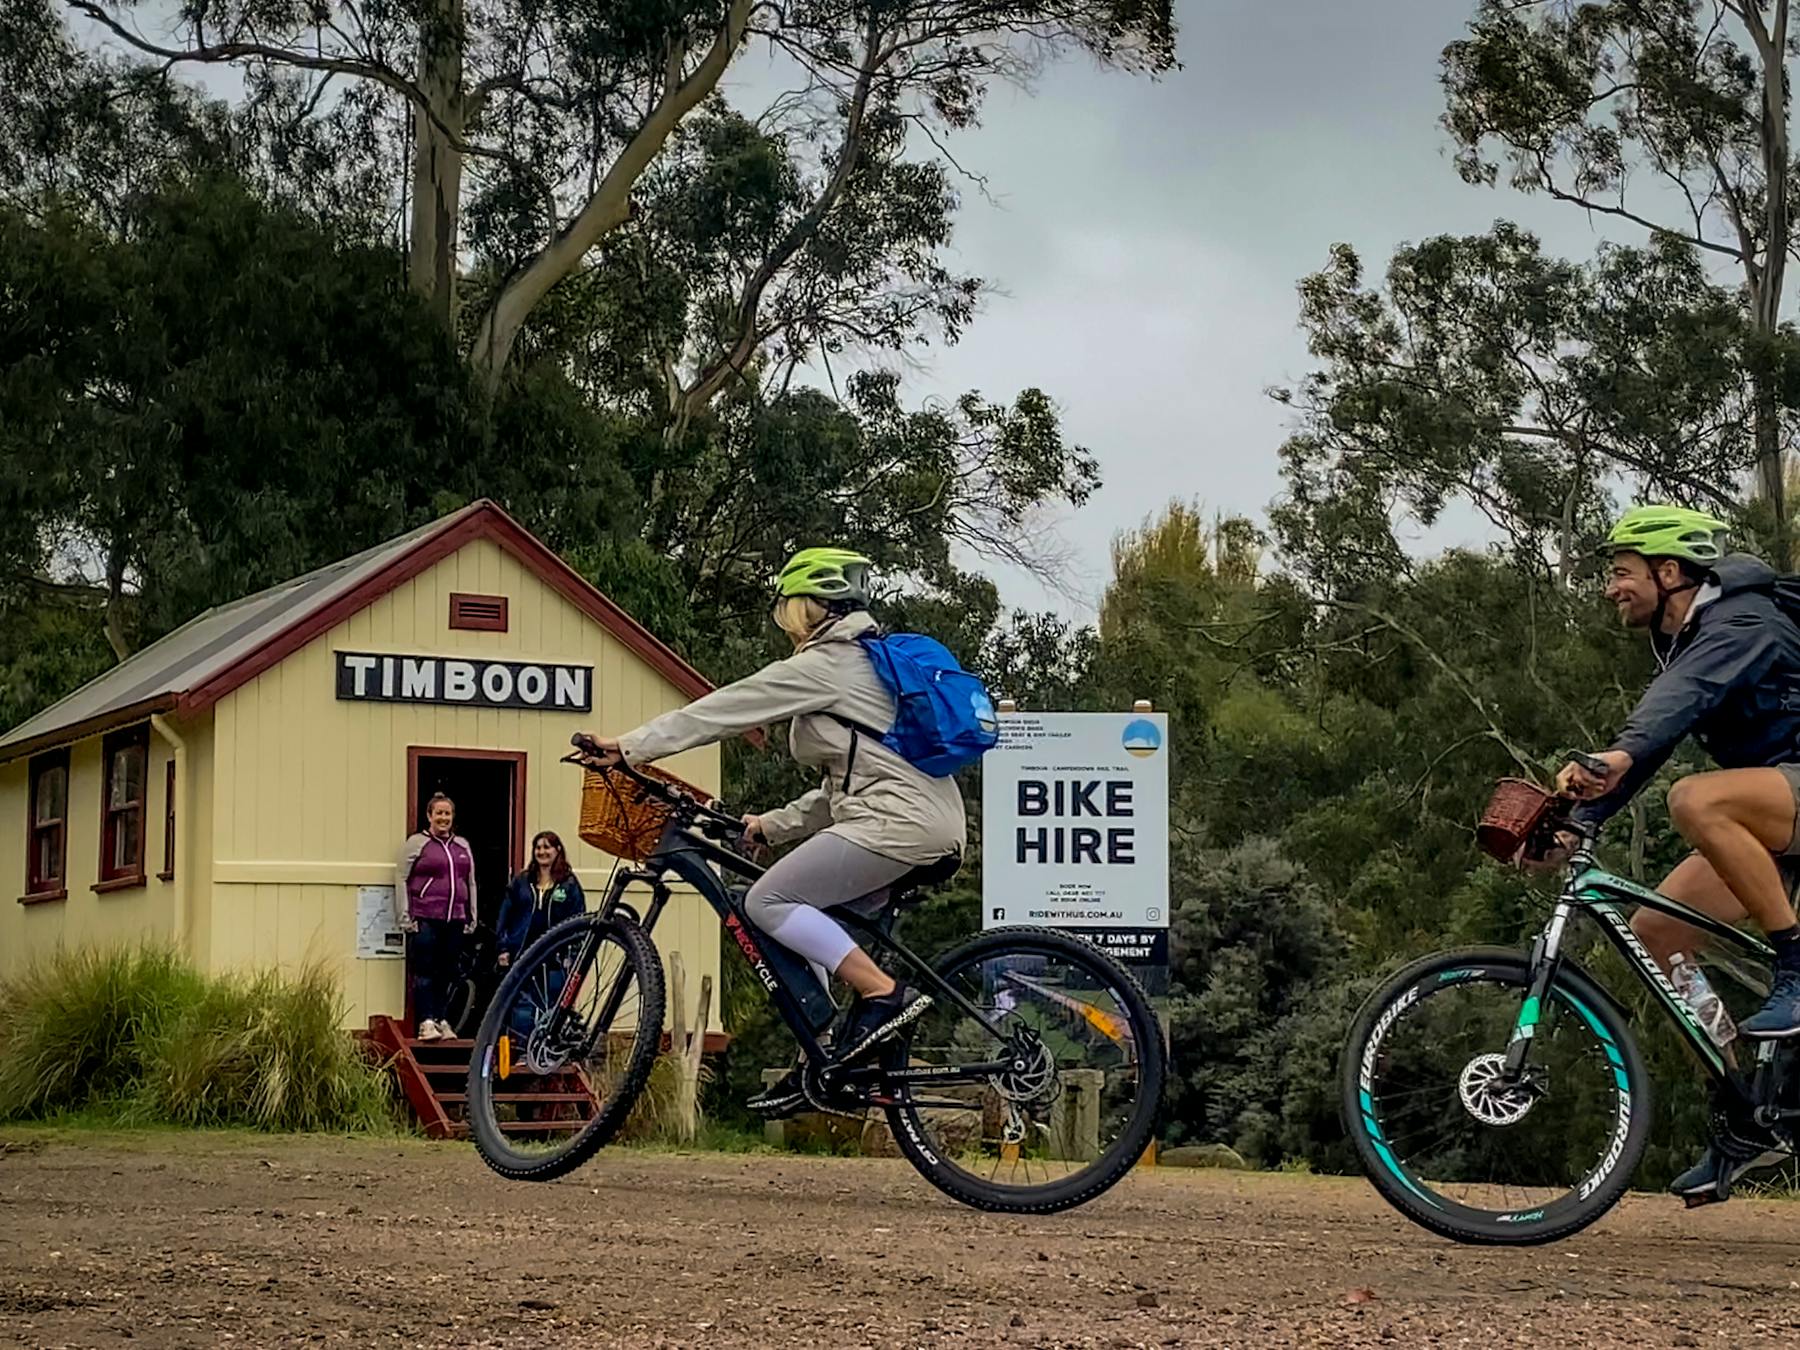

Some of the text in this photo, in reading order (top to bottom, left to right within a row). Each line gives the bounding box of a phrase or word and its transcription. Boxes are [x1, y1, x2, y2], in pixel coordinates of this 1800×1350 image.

[344, 655, 586, 707] TIMBOON
[1017, 780, 1134, 817] BIKE
[1016, 827, 1136, 864] HIRE
[1028, 910, 1123, 919] RIDEWITHUS.COM.AU
[1095, 934, 1104, 944] 7
[1106, 934, 1137, 945] DAYS
[1139, 934, 1156, 945] BY
[1604, 911, 1700, 1028] EUROBIKE
[1360, 985, 1420, 1093] EUROBIKE
[1578, 1088, 1633, 1202] EUROBIKE
